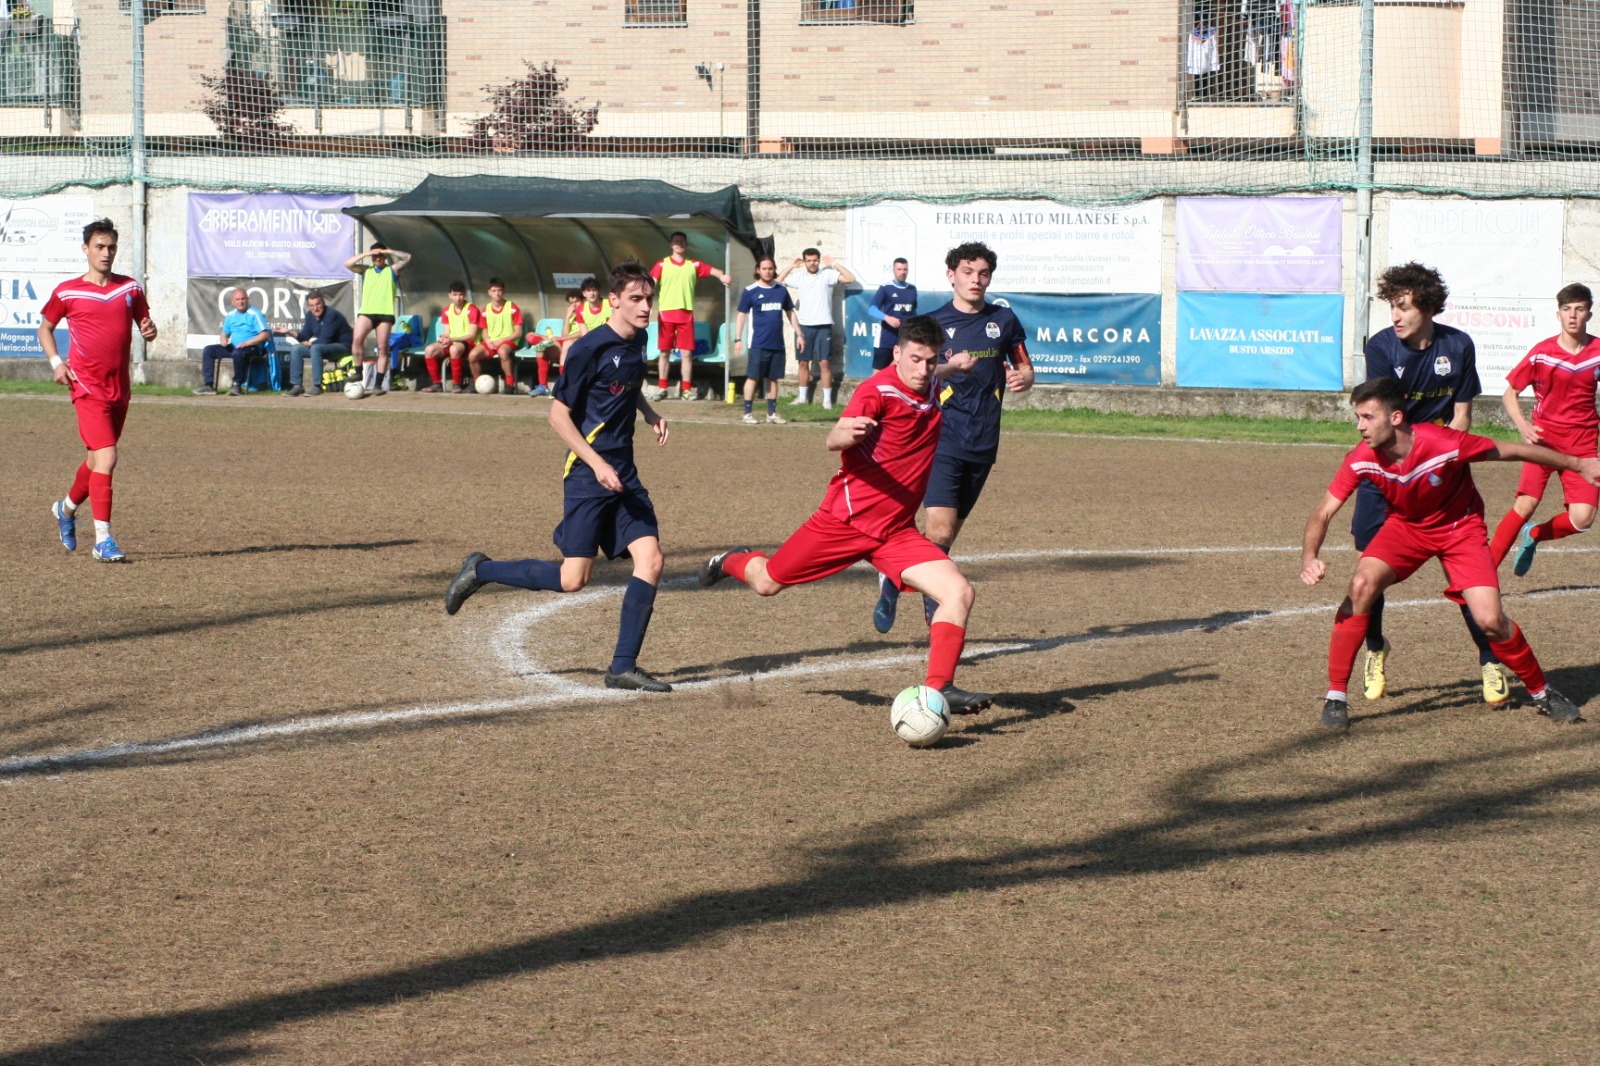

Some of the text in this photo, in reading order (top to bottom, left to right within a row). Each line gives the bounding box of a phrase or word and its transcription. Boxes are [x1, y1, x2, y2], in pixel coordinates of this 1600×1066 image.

[199, 208, 303, 233] ARREDAMENTI
[936, 212, 1004, 225] FERRIERA
[1009, 212, 1044, 225] ALTO
[1048, 212, 1120, 225] MILANESE
[1414, 208, 1541, 234] VERDE ACQUA
[950, 229, 1135, 242] Laminati e profili speciali in barre e rotoli
[1200, 224, 1321, 240] Istituto Ottico Bustese
[224, 239, 240, 248] VIALE
[271, 240, 291, 249] BUSTO
[0, 332, 35, 343] Magnago
[1036, 327, 1151, 343] MARCORA
[1189, 327, 1246, 341] LAVAZZA
[1248, 328, 1319, 343] ASSOCIATI
[859, 349, 872, 357] Via
[1229, 345, 1294, 355] BUSTO ARSIZIO
[1080, 355, 1091, 363] fax
[1093, 355, 1141, 364] 0297241390
[1033, 365, 1087, 374] marcora.it
